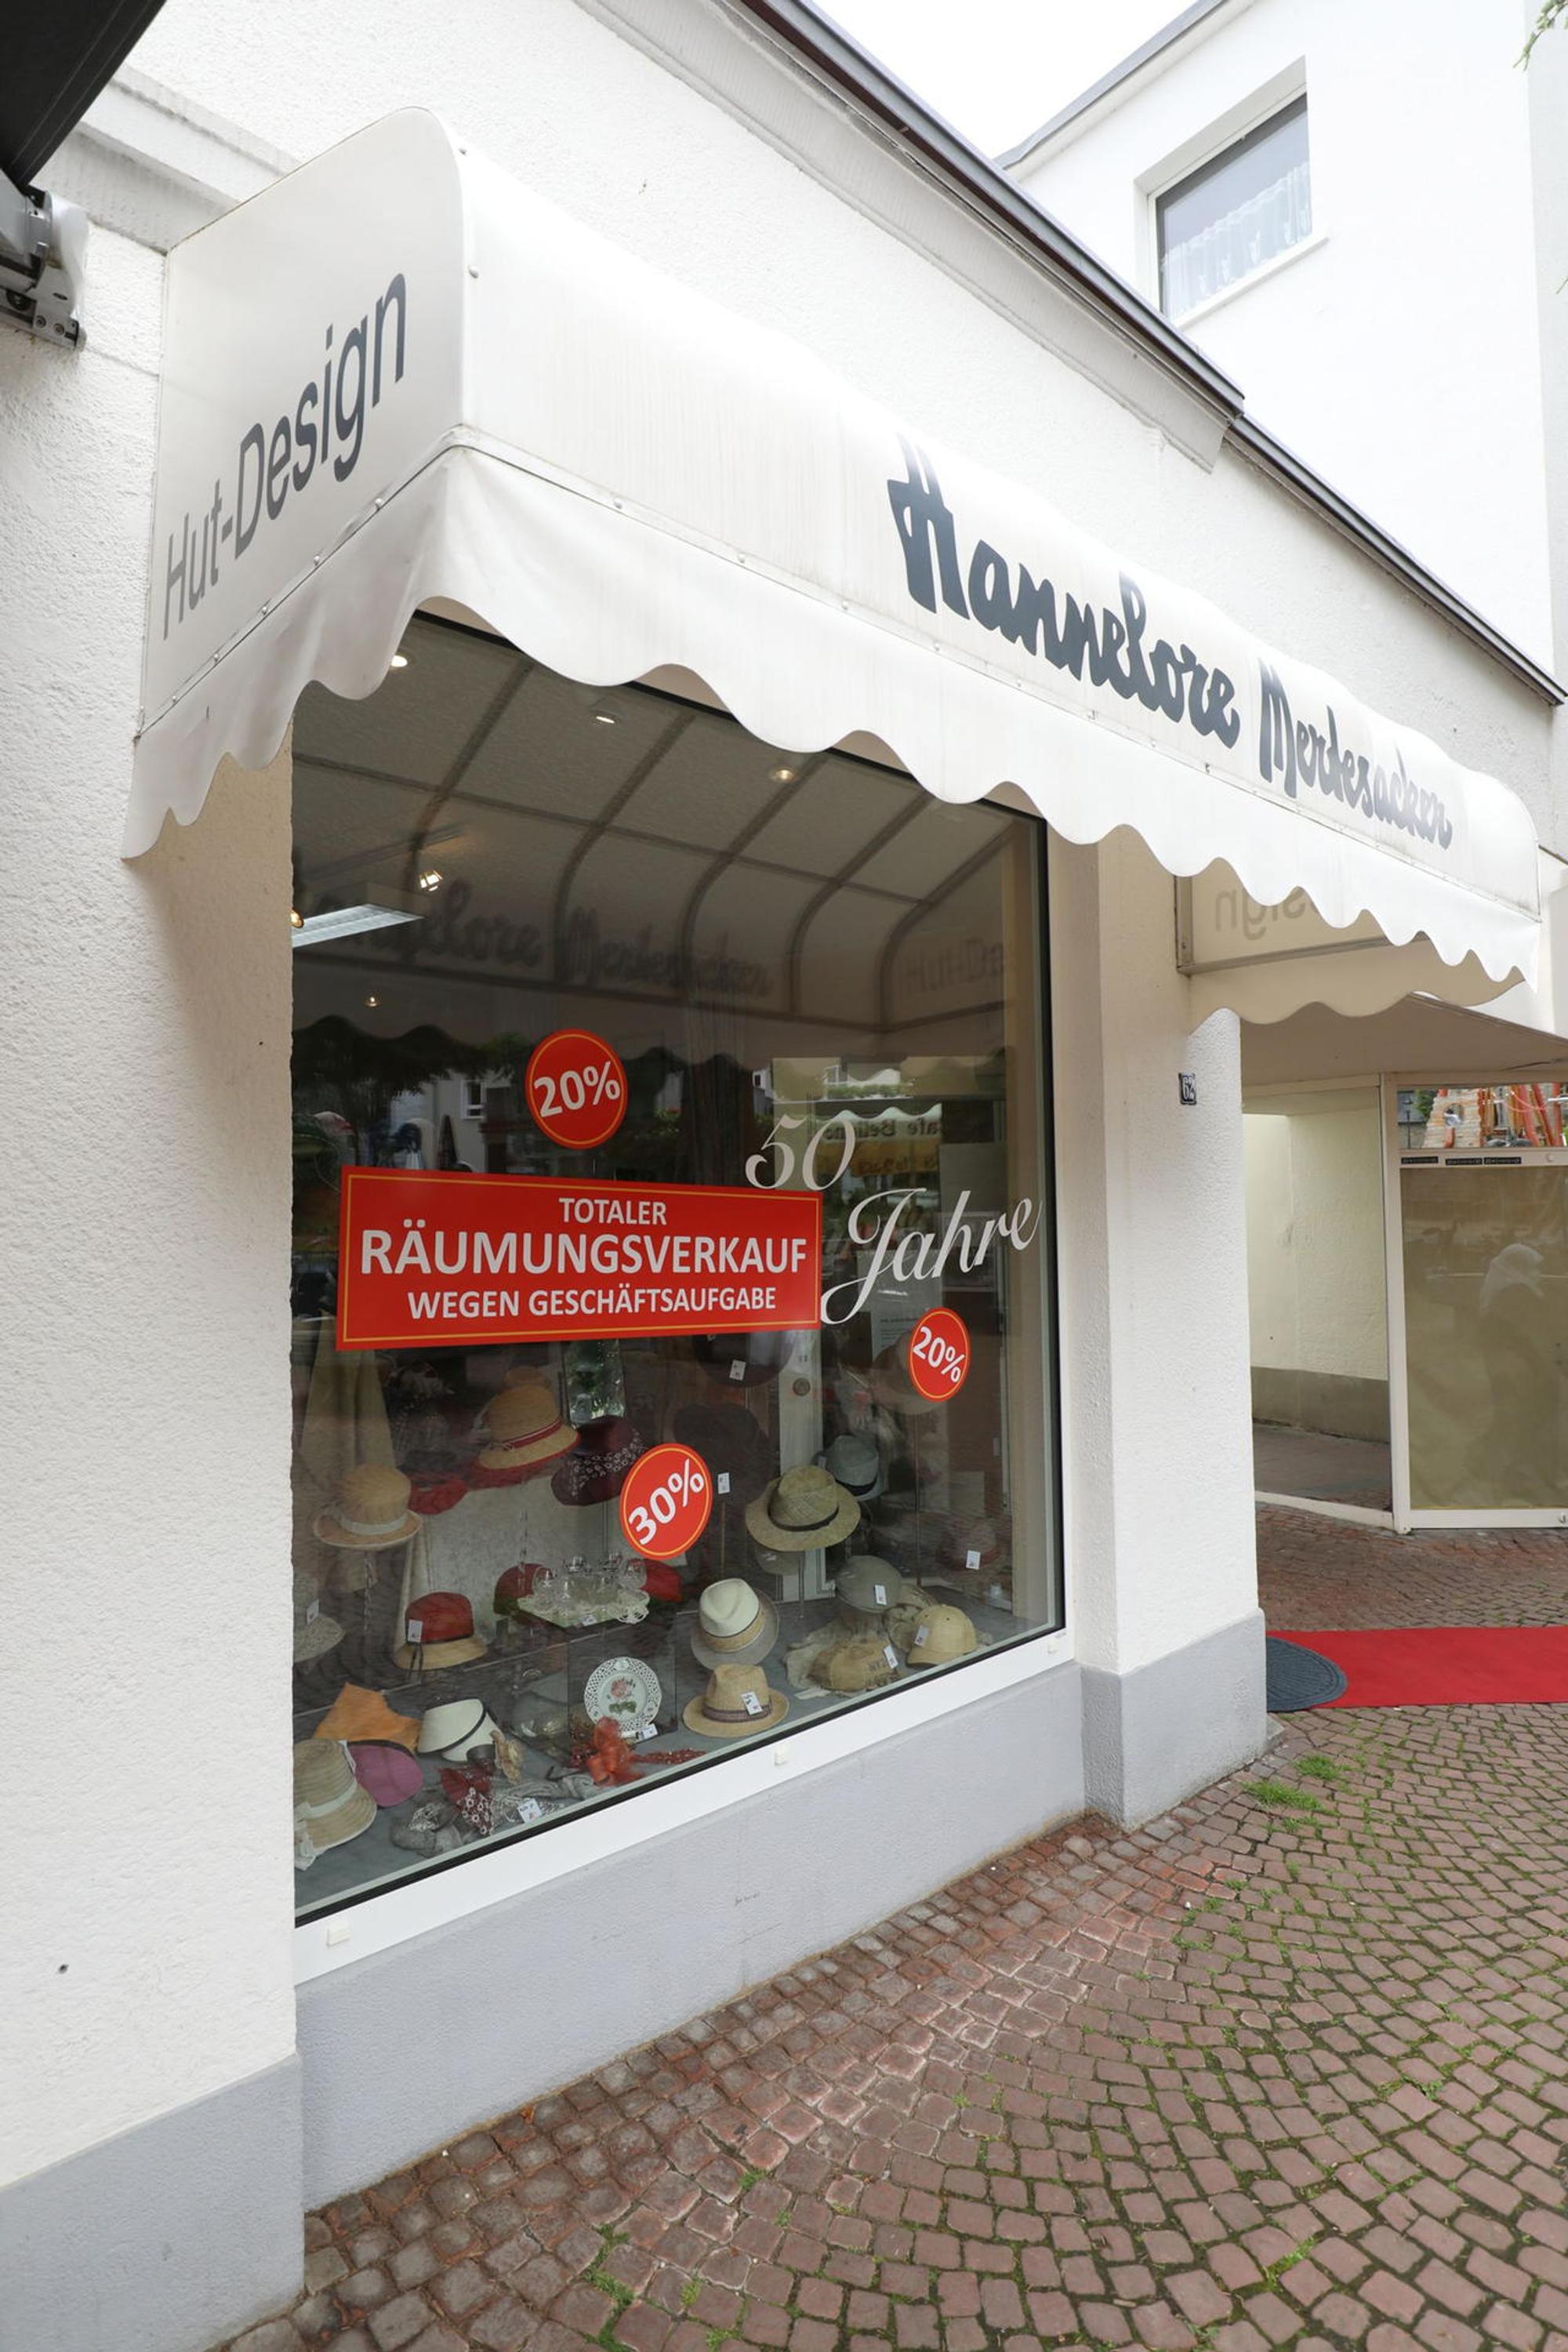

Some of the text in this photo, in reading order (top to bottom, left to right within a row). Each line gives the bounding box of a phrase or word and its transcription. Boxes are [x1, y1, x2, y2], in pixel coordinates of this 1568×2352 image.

[163, 272, 407, 641] Hut-Design
[887, 431, 1240, 749] Hannelore
[534, 1061, 621, 1117] 20%
[745, 1114, 856, 1192] 50
[558, 1197, 667, 1225] TOTALER
[361, 1218, 808, 1275] RÄUMUNGSVERKAUF
[820, 1187, 1044, 1326] Jahre
[407, 1283, 776, 1319] WEGEN GESCHÄFTSAUFGABE
[913, 1326, 965, 1384] 20%
[628, 1457, 705, 1546] 30%
